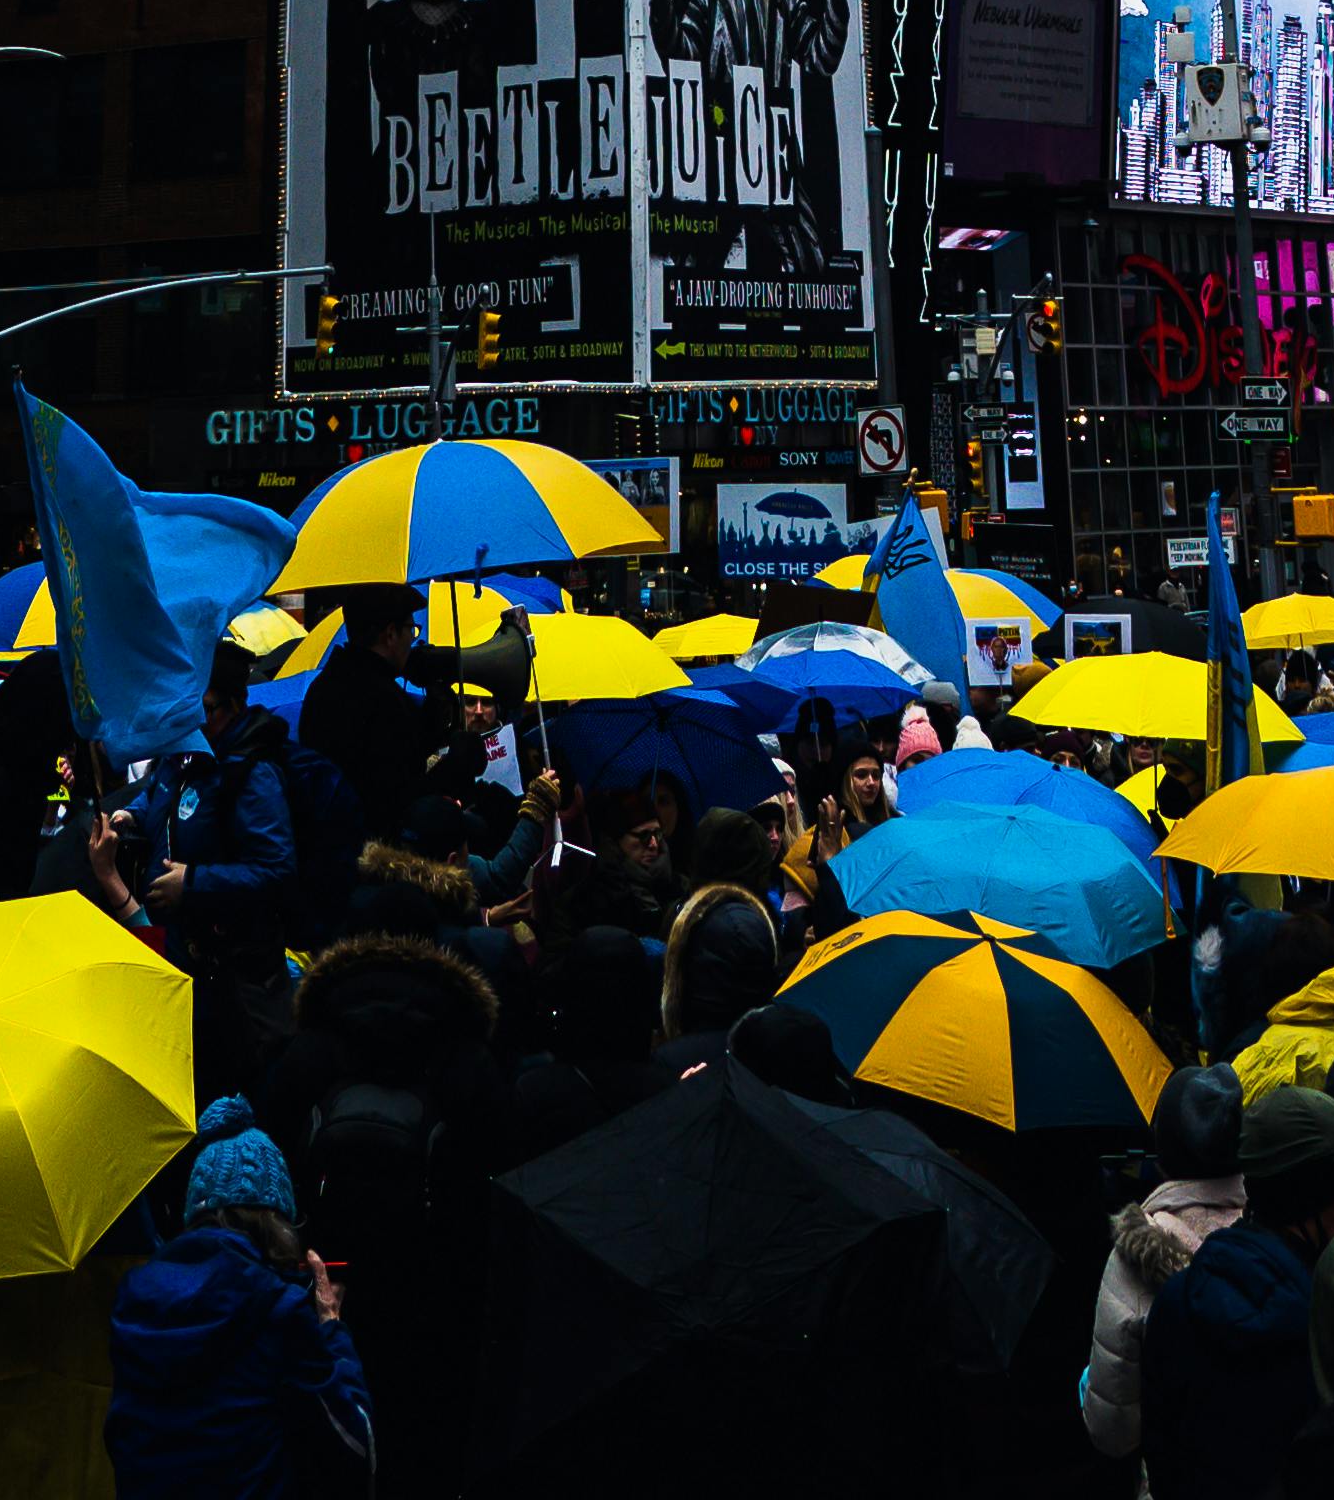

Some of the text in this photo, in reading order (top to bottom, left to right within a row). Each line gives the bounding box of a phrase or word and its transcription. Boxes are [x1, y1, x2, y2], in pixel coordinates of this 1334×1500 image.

[444, 213, 671, 245] The The The
[685, 280, 783, 310] JAW-DROPPING
[532, 341, 625, 360] 50TH & BROADWAY
[689, 342, 798, 358] THIS WAY TO THE NETHERWORLD
[834, 343, 870, 360] BROADWAY
[293, 357, 316, 373] NOW
[317, 357, 332, 371] ON
[1248, 386, 1283, 399] ONE WAY
[648, 388, 859, 425] GIFTS LUGGAGE
[204, 398, 541, 446] GIFTS LUGGAGE
[1226, 417, 1280, 431] ONE WAY
[753, 426, 780, 447] NY
[692, 452, 725, 470] Nikon
[778, 452, 820, 467] SONY
[256, 472, 298, 488] Nikon
[724, 561, 776, 576] CLOSE
[779, 561, 809, 576] THE
